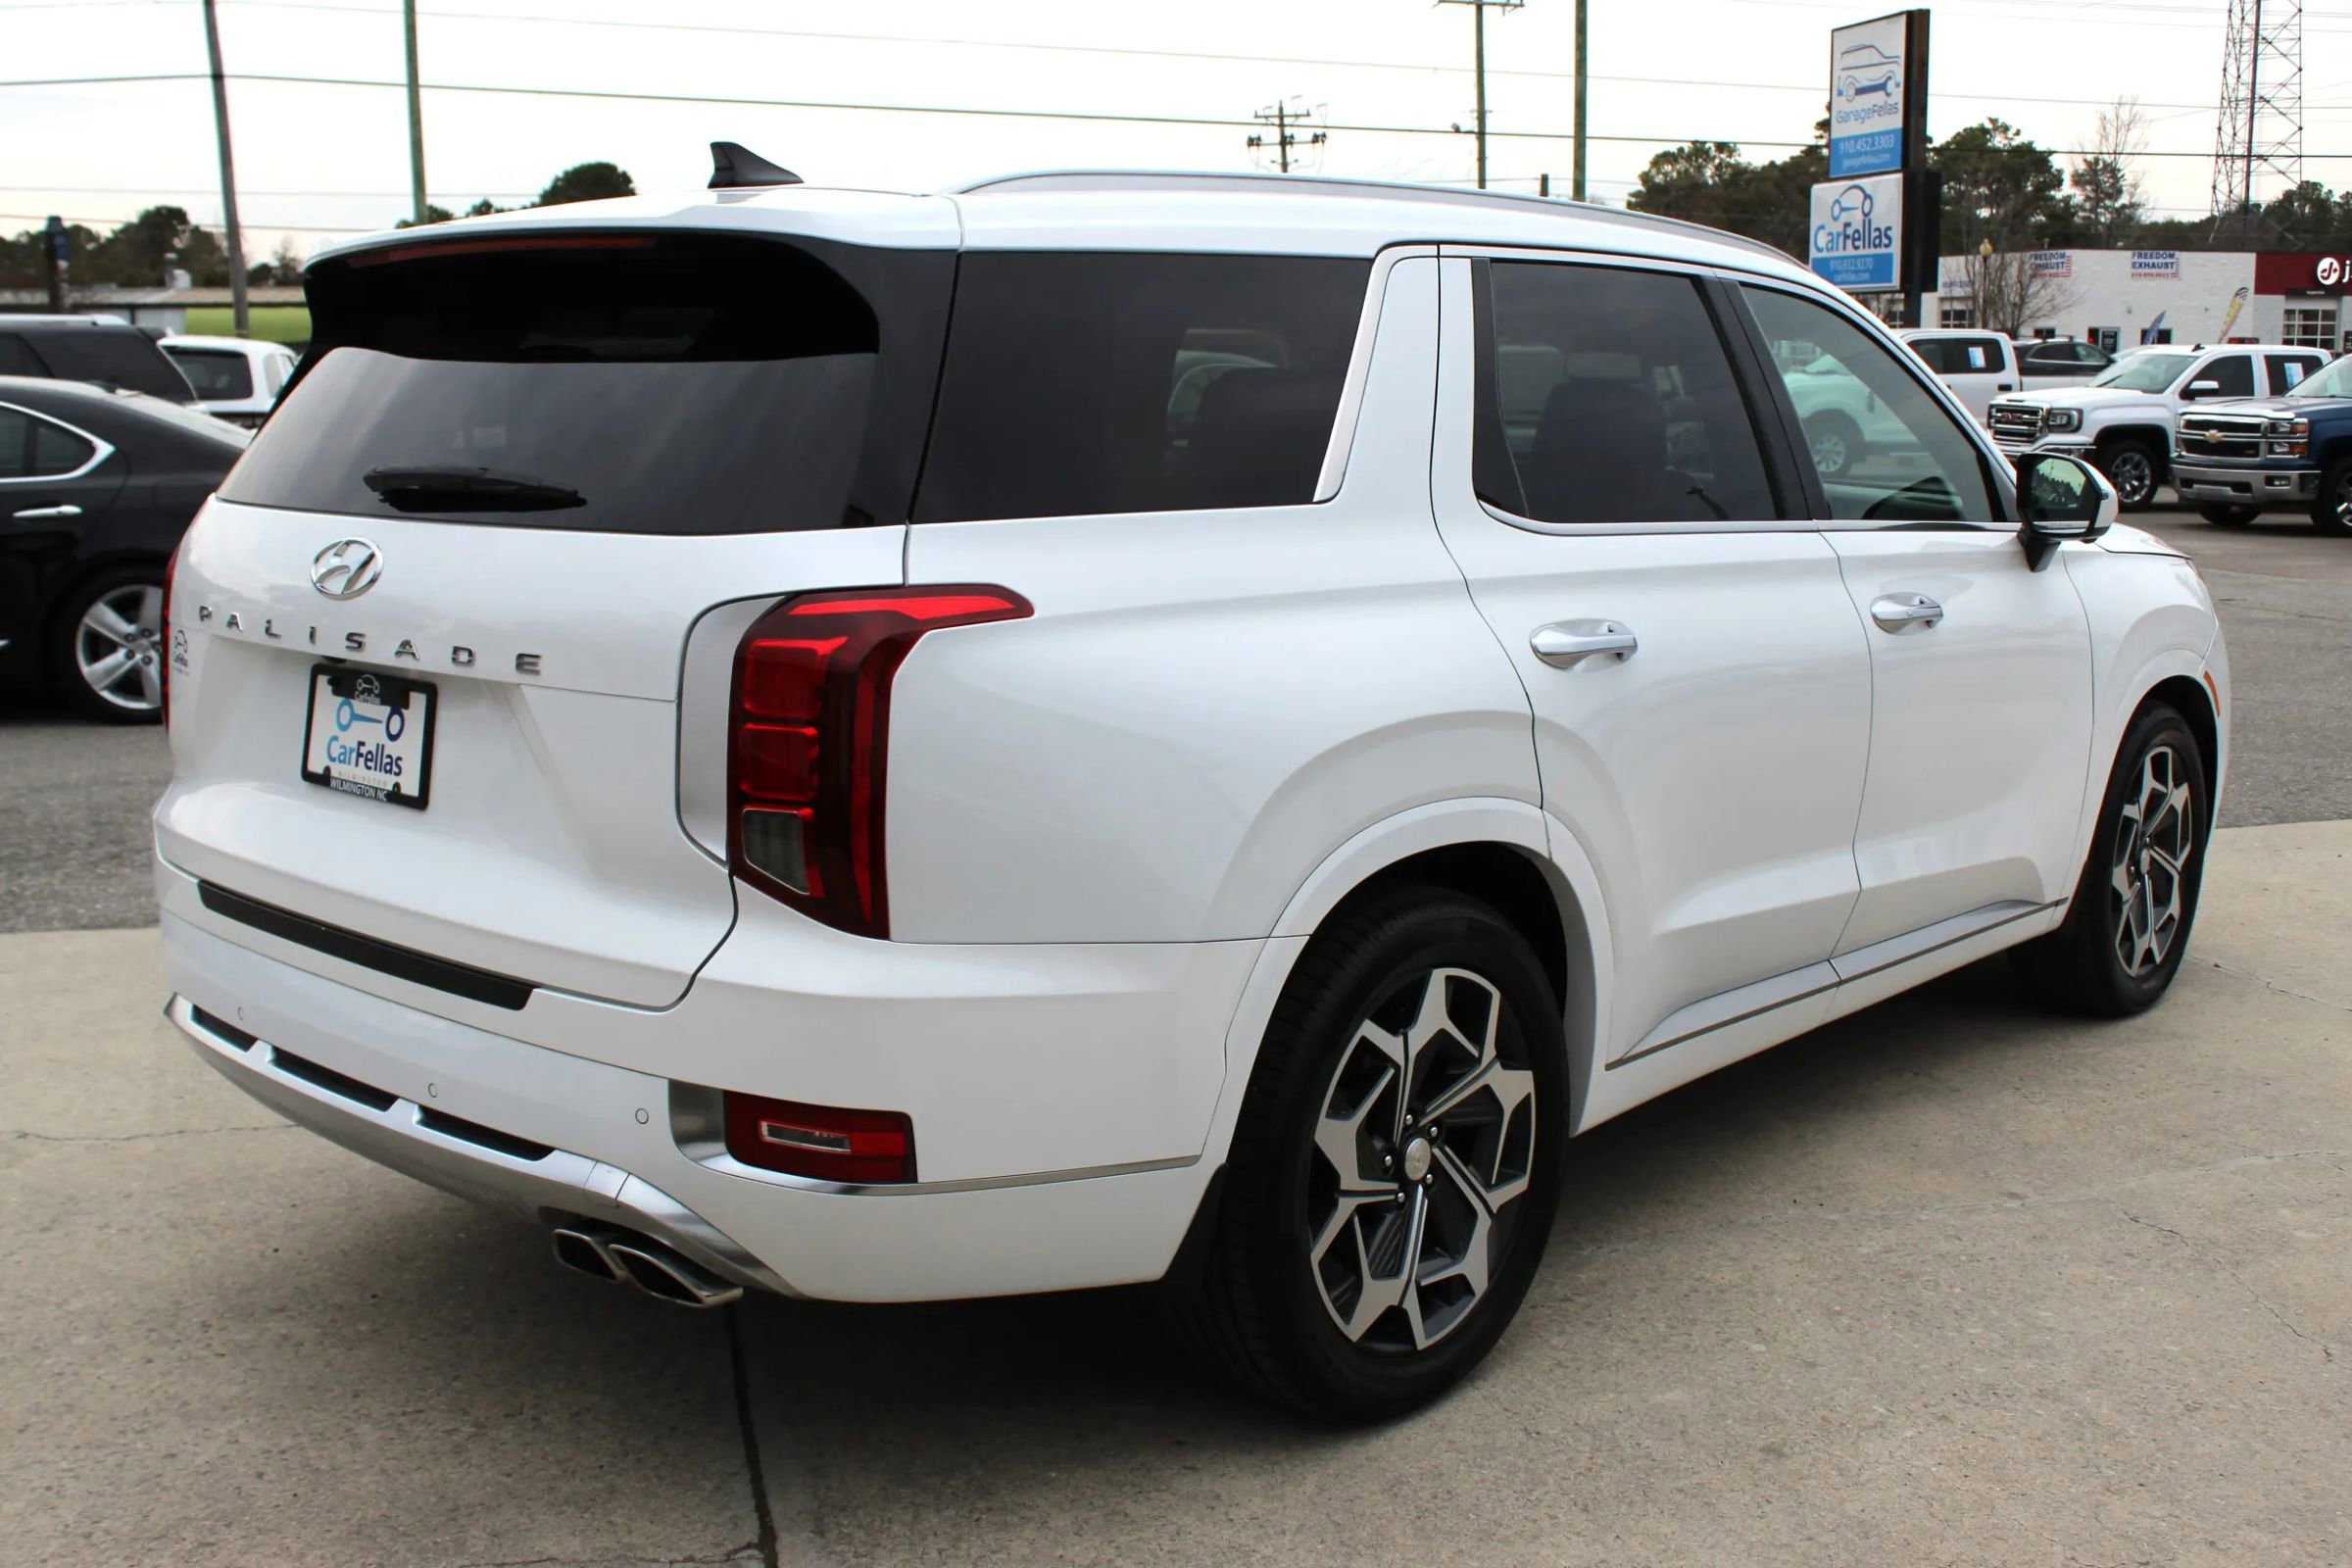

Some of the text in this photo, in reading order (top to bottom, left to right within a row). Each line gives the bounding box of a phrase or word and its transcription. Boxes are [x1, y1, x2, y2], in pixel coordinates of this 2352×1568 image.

[1836, 100, 1899, 123] GarageFellas
[1838, 134, 1896, 155] 910.452.3303
[1814, 218, 1893, 253] CarFellas
[2132, 251, 2176, 260] FREEDOM
[2132, 261, 2176, 270] EXHAUST
[199, 606, 542, 676] PALISADE
[326, 735, 404, 777] CarFellas
[329, 778, 389, 802] WILMINGTON NC
